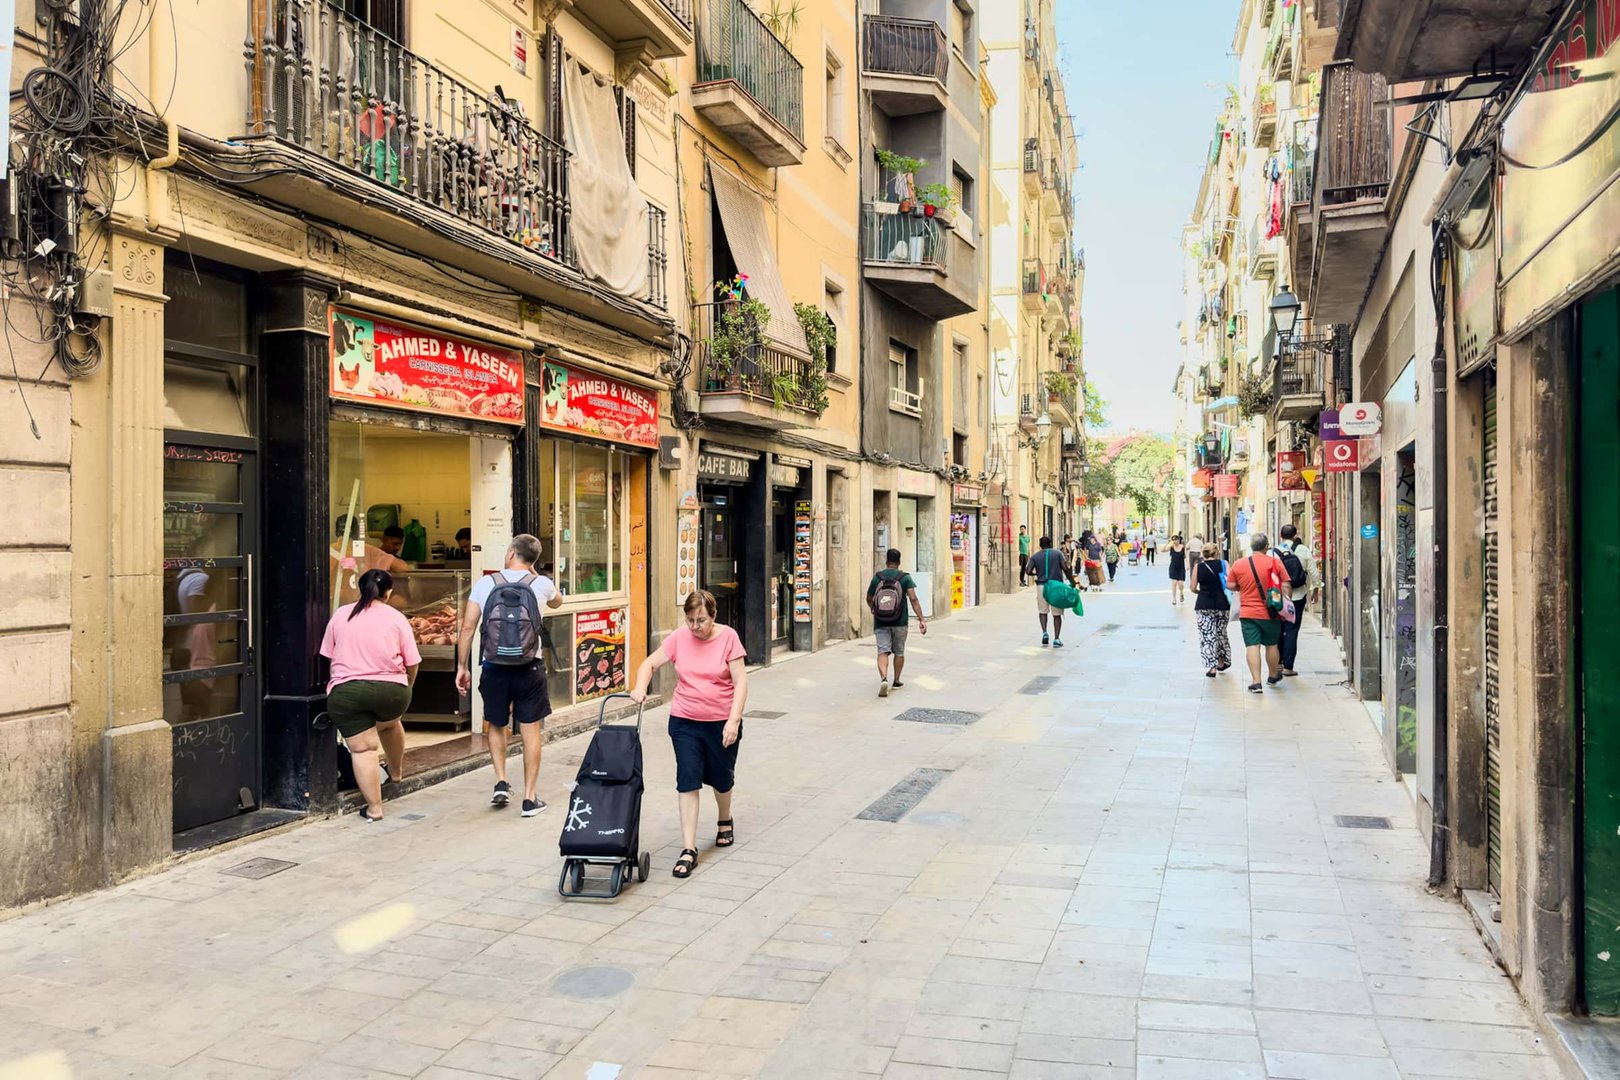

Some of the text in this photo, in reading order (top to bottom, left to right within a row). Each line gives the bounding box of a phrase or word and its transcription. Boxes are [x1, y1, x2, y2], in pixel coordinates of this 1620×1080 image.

[381, 337, 440, 363] AHMED
[445, 341, 457, 360] &
[461, 345, 519, 388] YASEEN
[408, 357, 461, 378] CARNISSERIA
[464, 369, 498, 384] ISLAMICA
[571, 380, 608, 401] AHMED
[610, 383, 618, 398] &
[620, 385, 655, 420] YASEEN
[698, 454, 749, 477] CAFE BAR
